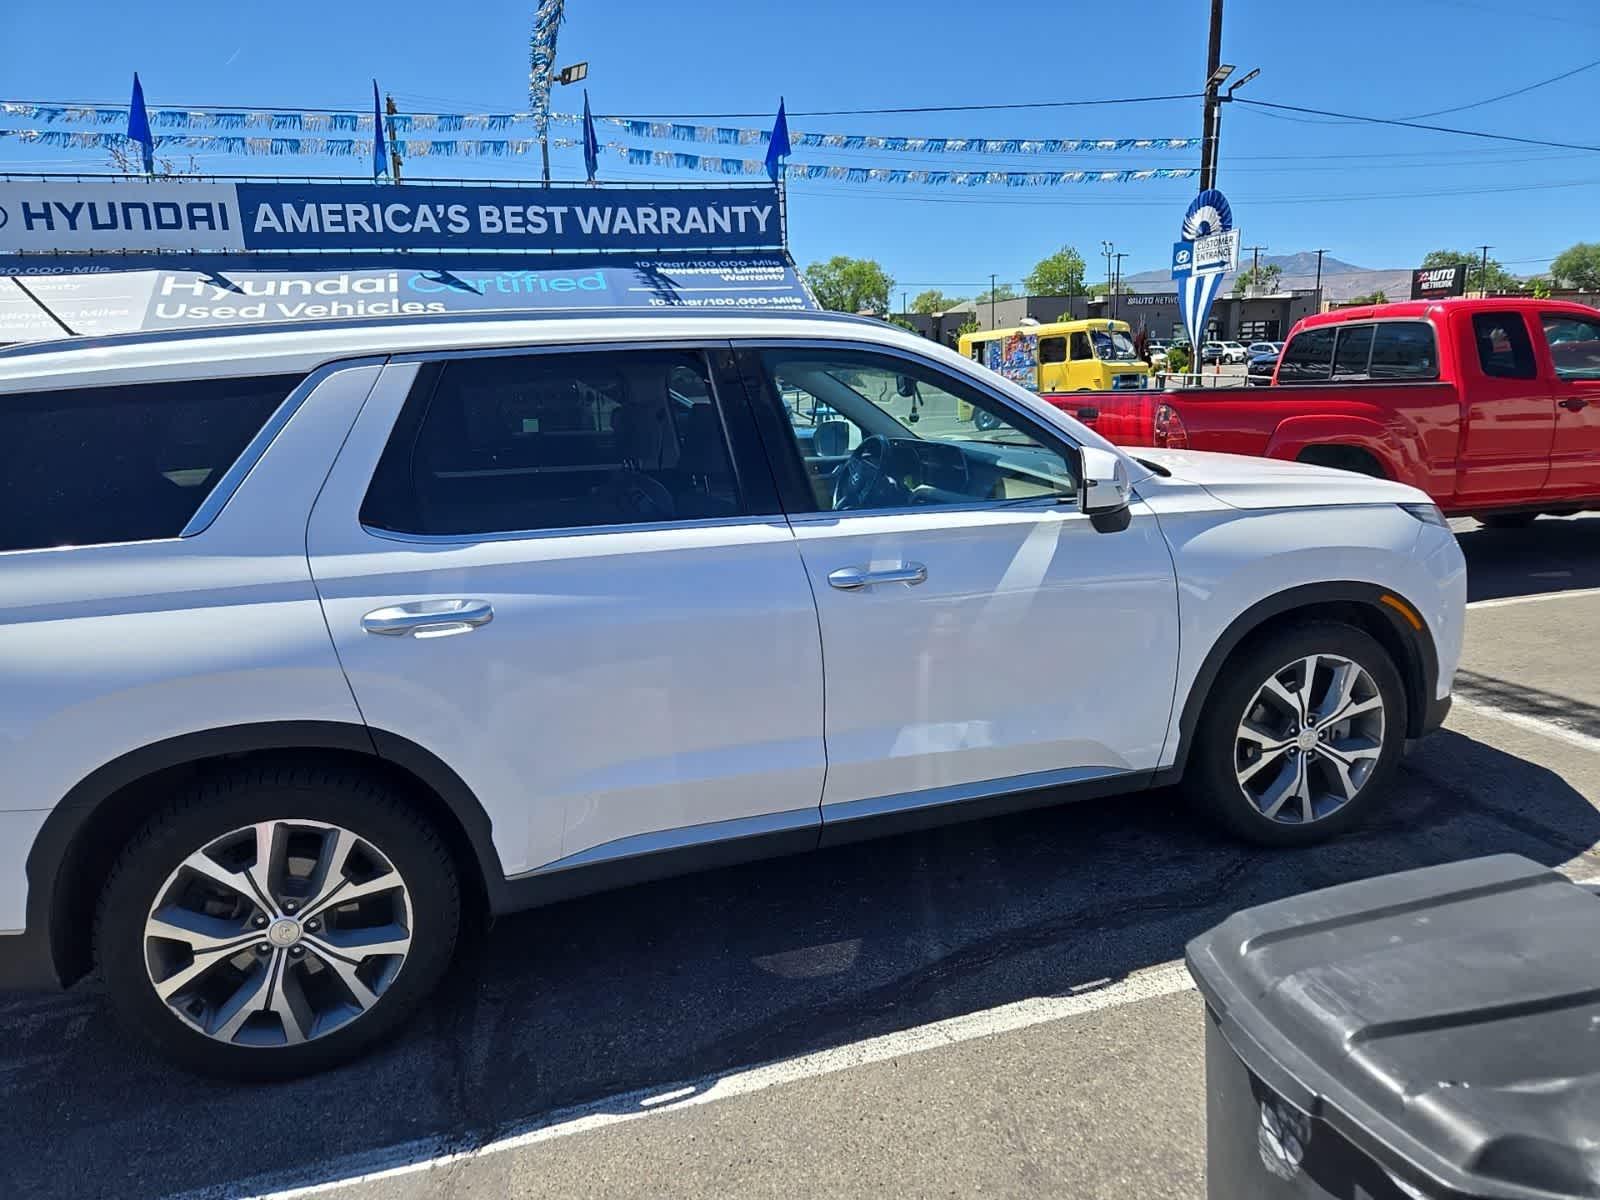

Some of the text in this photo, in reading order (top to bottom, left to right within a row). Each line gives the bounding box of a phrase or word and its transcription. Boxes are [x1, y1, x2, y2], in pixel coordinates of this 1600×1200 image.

[22, 201, 230, 231] HYUNDAI
[253, 202, 773, 234] AMERICA'S BEST WARRANTY
[1197, 235, 1234, 250] CUSTOMER
[1196, 247, 1232, 262] ENTRANCE
[720, 273, 785, 281] Warranty
[733, 266, 784, 274] Limited
[160, 271, 398, 301] Hyundai
[155, 299, 446, 319] Used Vehicles
